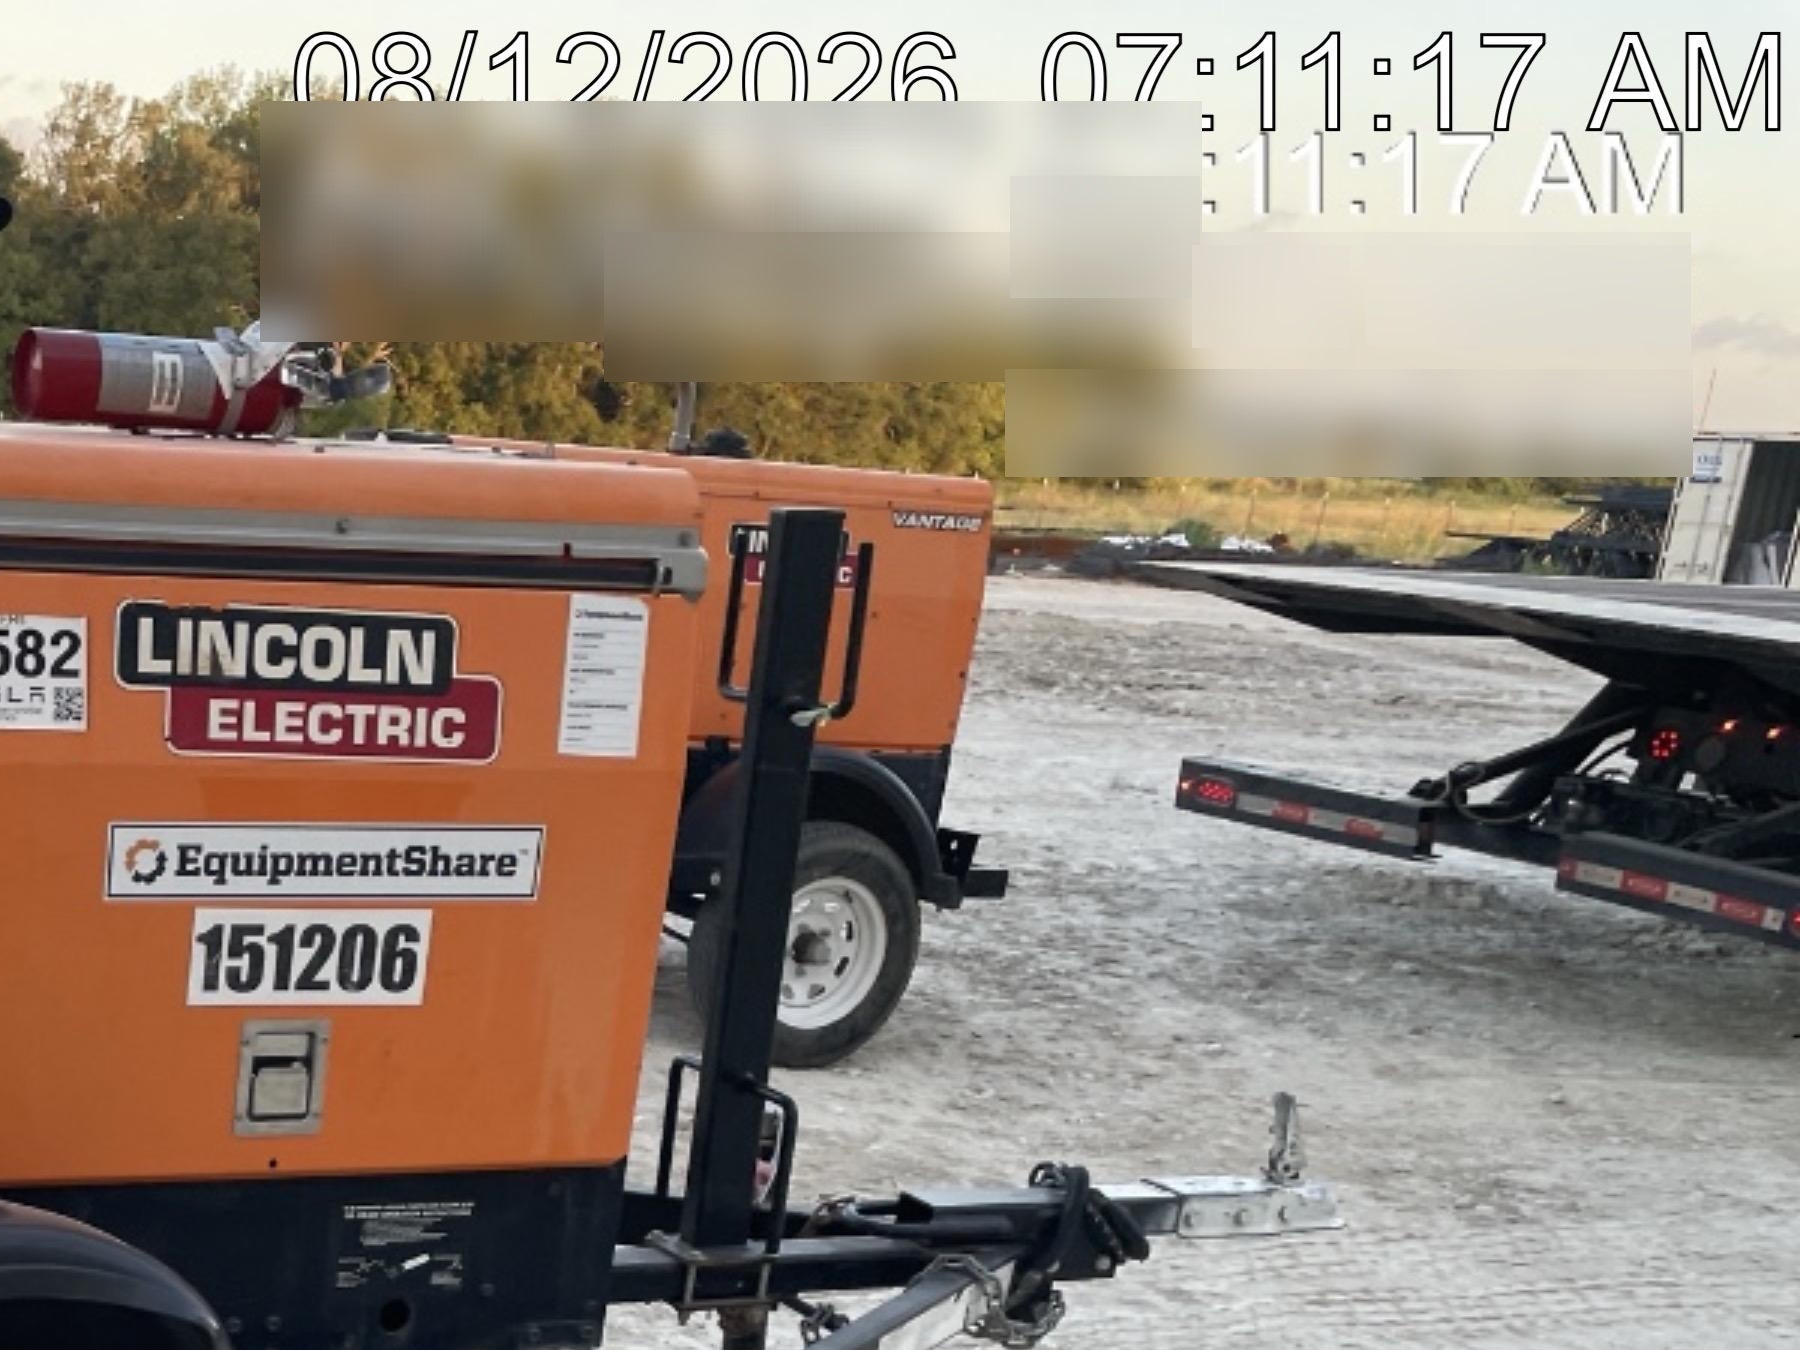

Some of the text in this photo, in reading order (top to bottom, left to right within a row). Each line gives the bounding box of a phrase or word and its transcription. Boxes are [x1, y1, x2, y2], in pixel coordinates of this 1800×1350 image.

[893, 511, 983, 532] VANTAGE
[136, 617, 437, 685] LINCOLN
[207, 698, 467, 749] ELECTRIC
[174, 843, 518, 886] EquipmentShare
[196, 923, 421, 993] 151206
